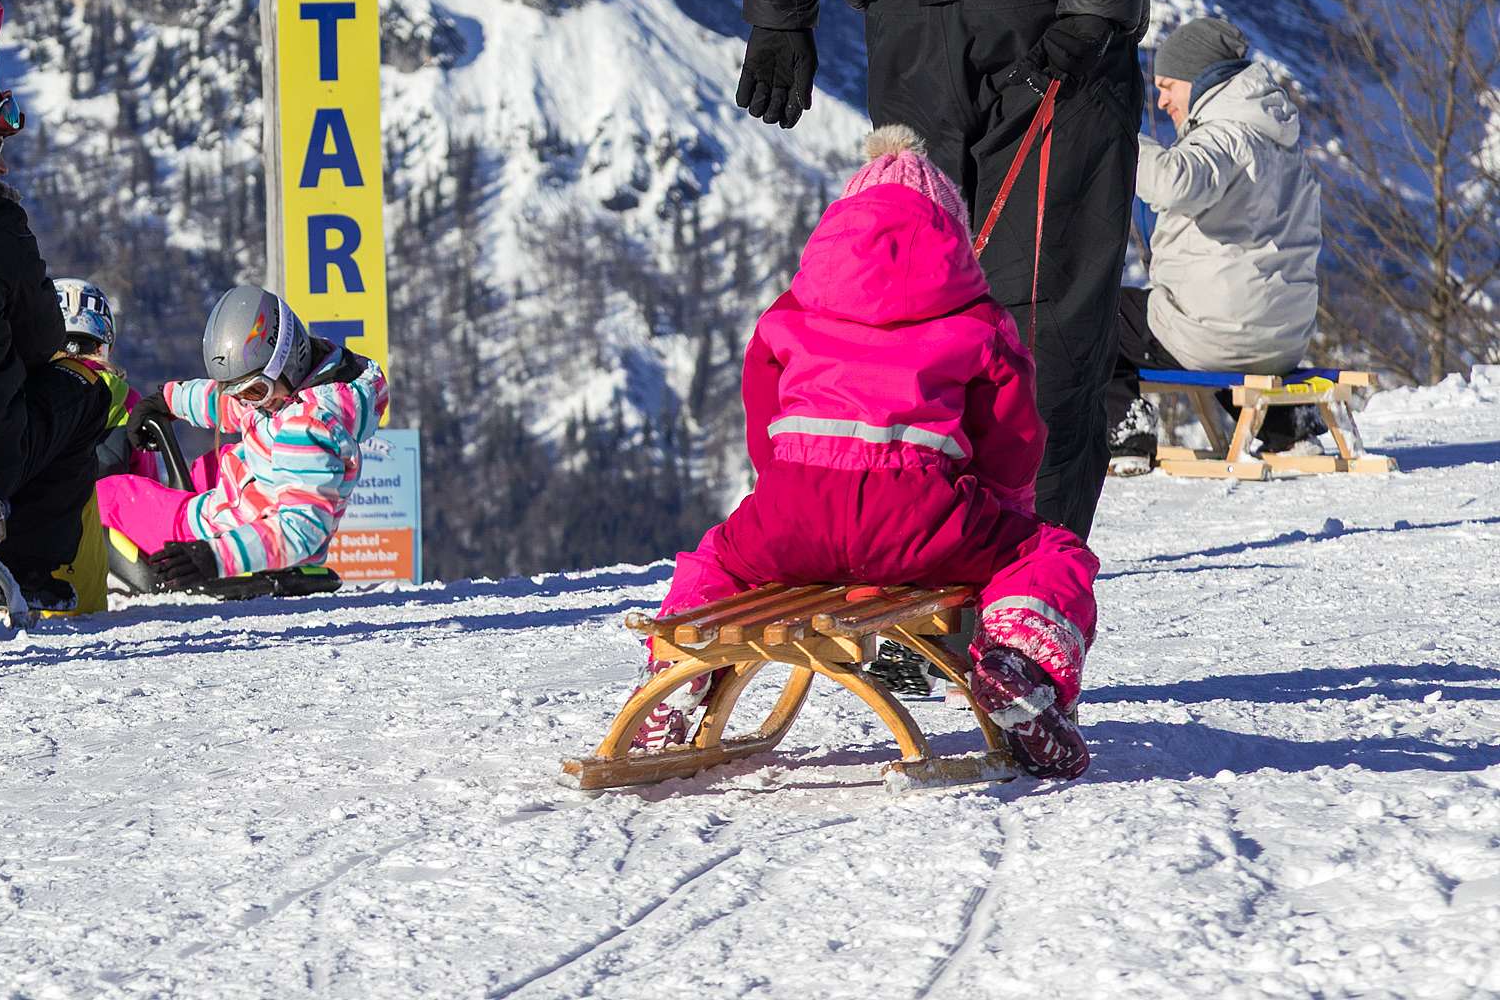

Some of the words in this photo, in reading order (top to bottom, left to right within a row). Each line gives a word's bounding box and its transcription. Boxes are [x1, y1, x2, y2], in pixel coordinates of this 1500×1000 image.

[357, 473, 402, 488] ustand
[346, 491, 393, 505] elbahn:
[340, 532, 380, 548] Buckel
